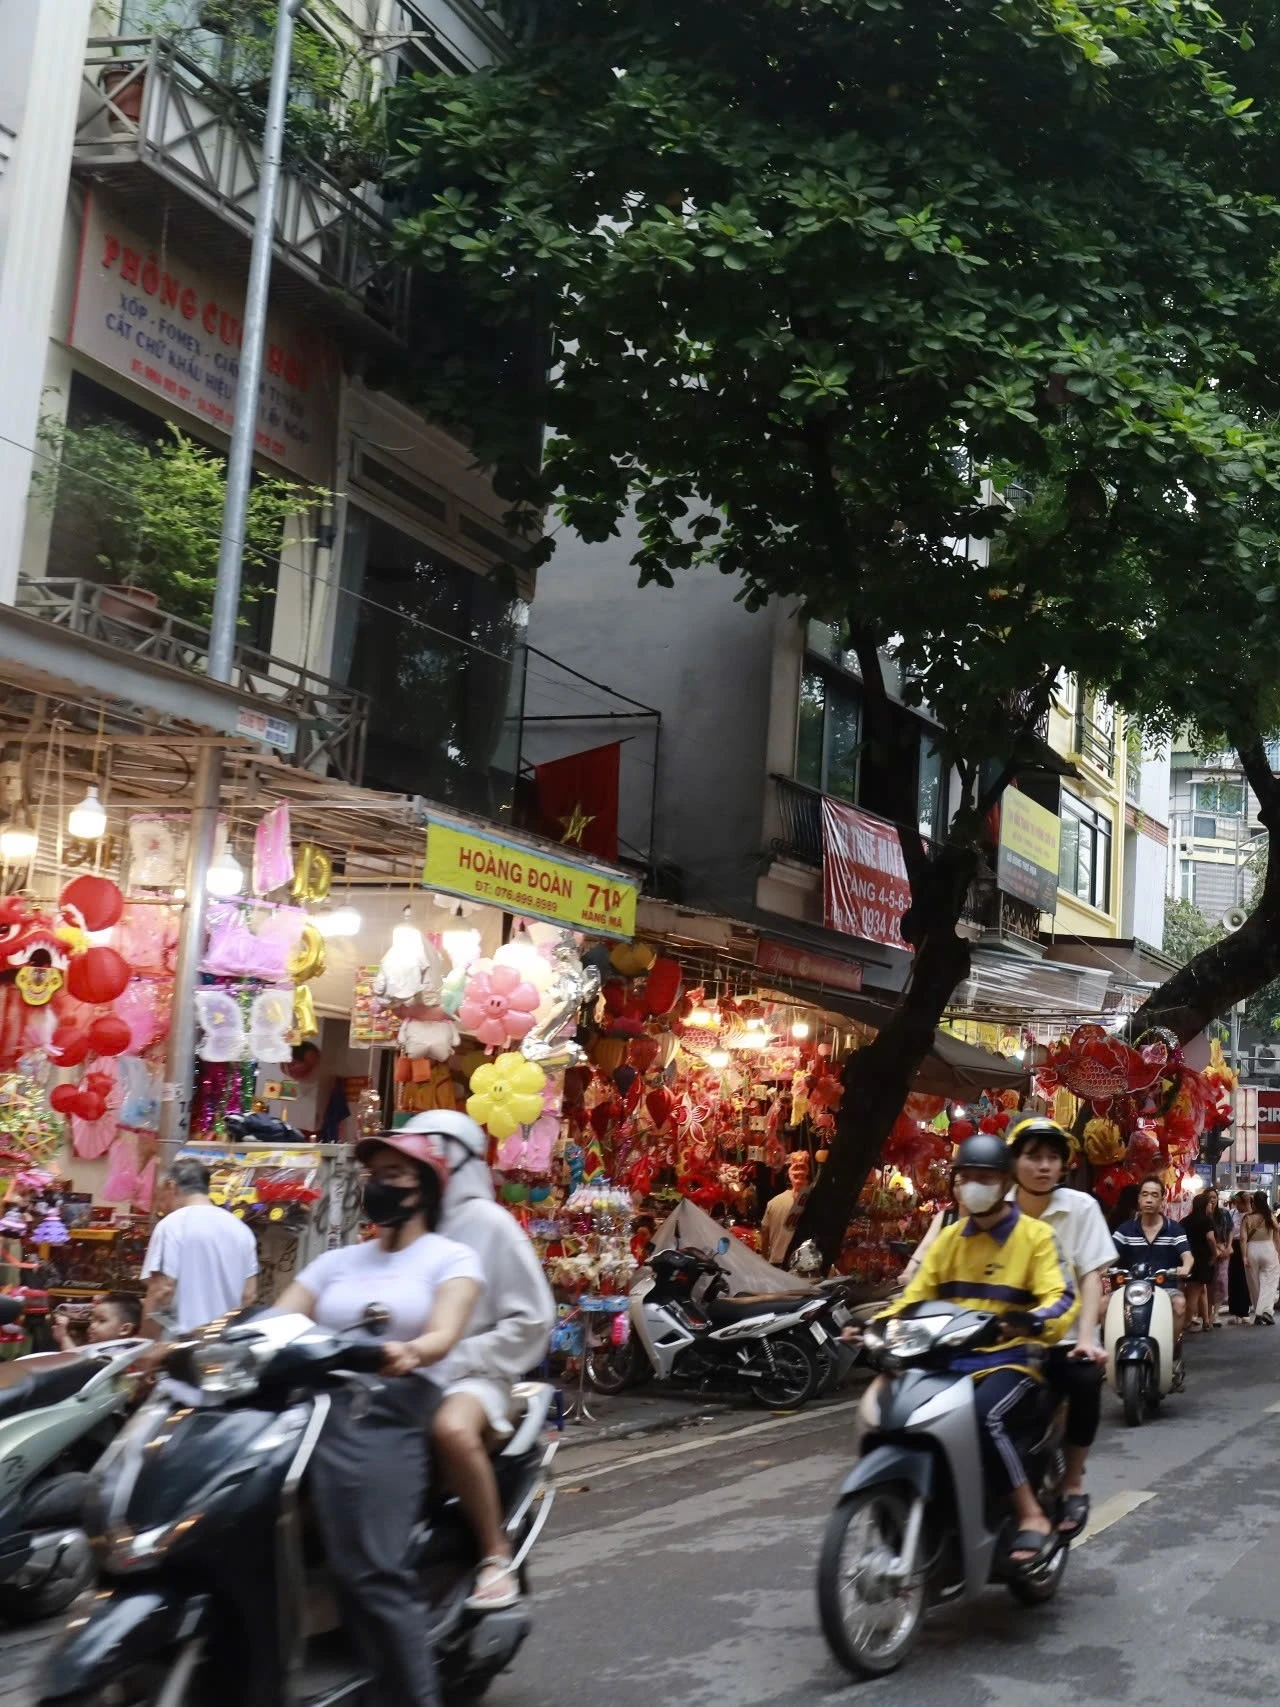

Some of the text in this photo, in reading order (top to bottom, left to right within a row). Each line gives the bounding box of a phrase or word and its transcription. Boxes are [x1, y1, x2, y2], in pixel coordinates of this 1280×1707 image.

[158, 319, 201, 357] FOMEX
[458, 847, 572, 899] HOÀNG ĐOÀN
[586, 883, 622, 912] 71A
[861, 905, 887, 938] 0934
